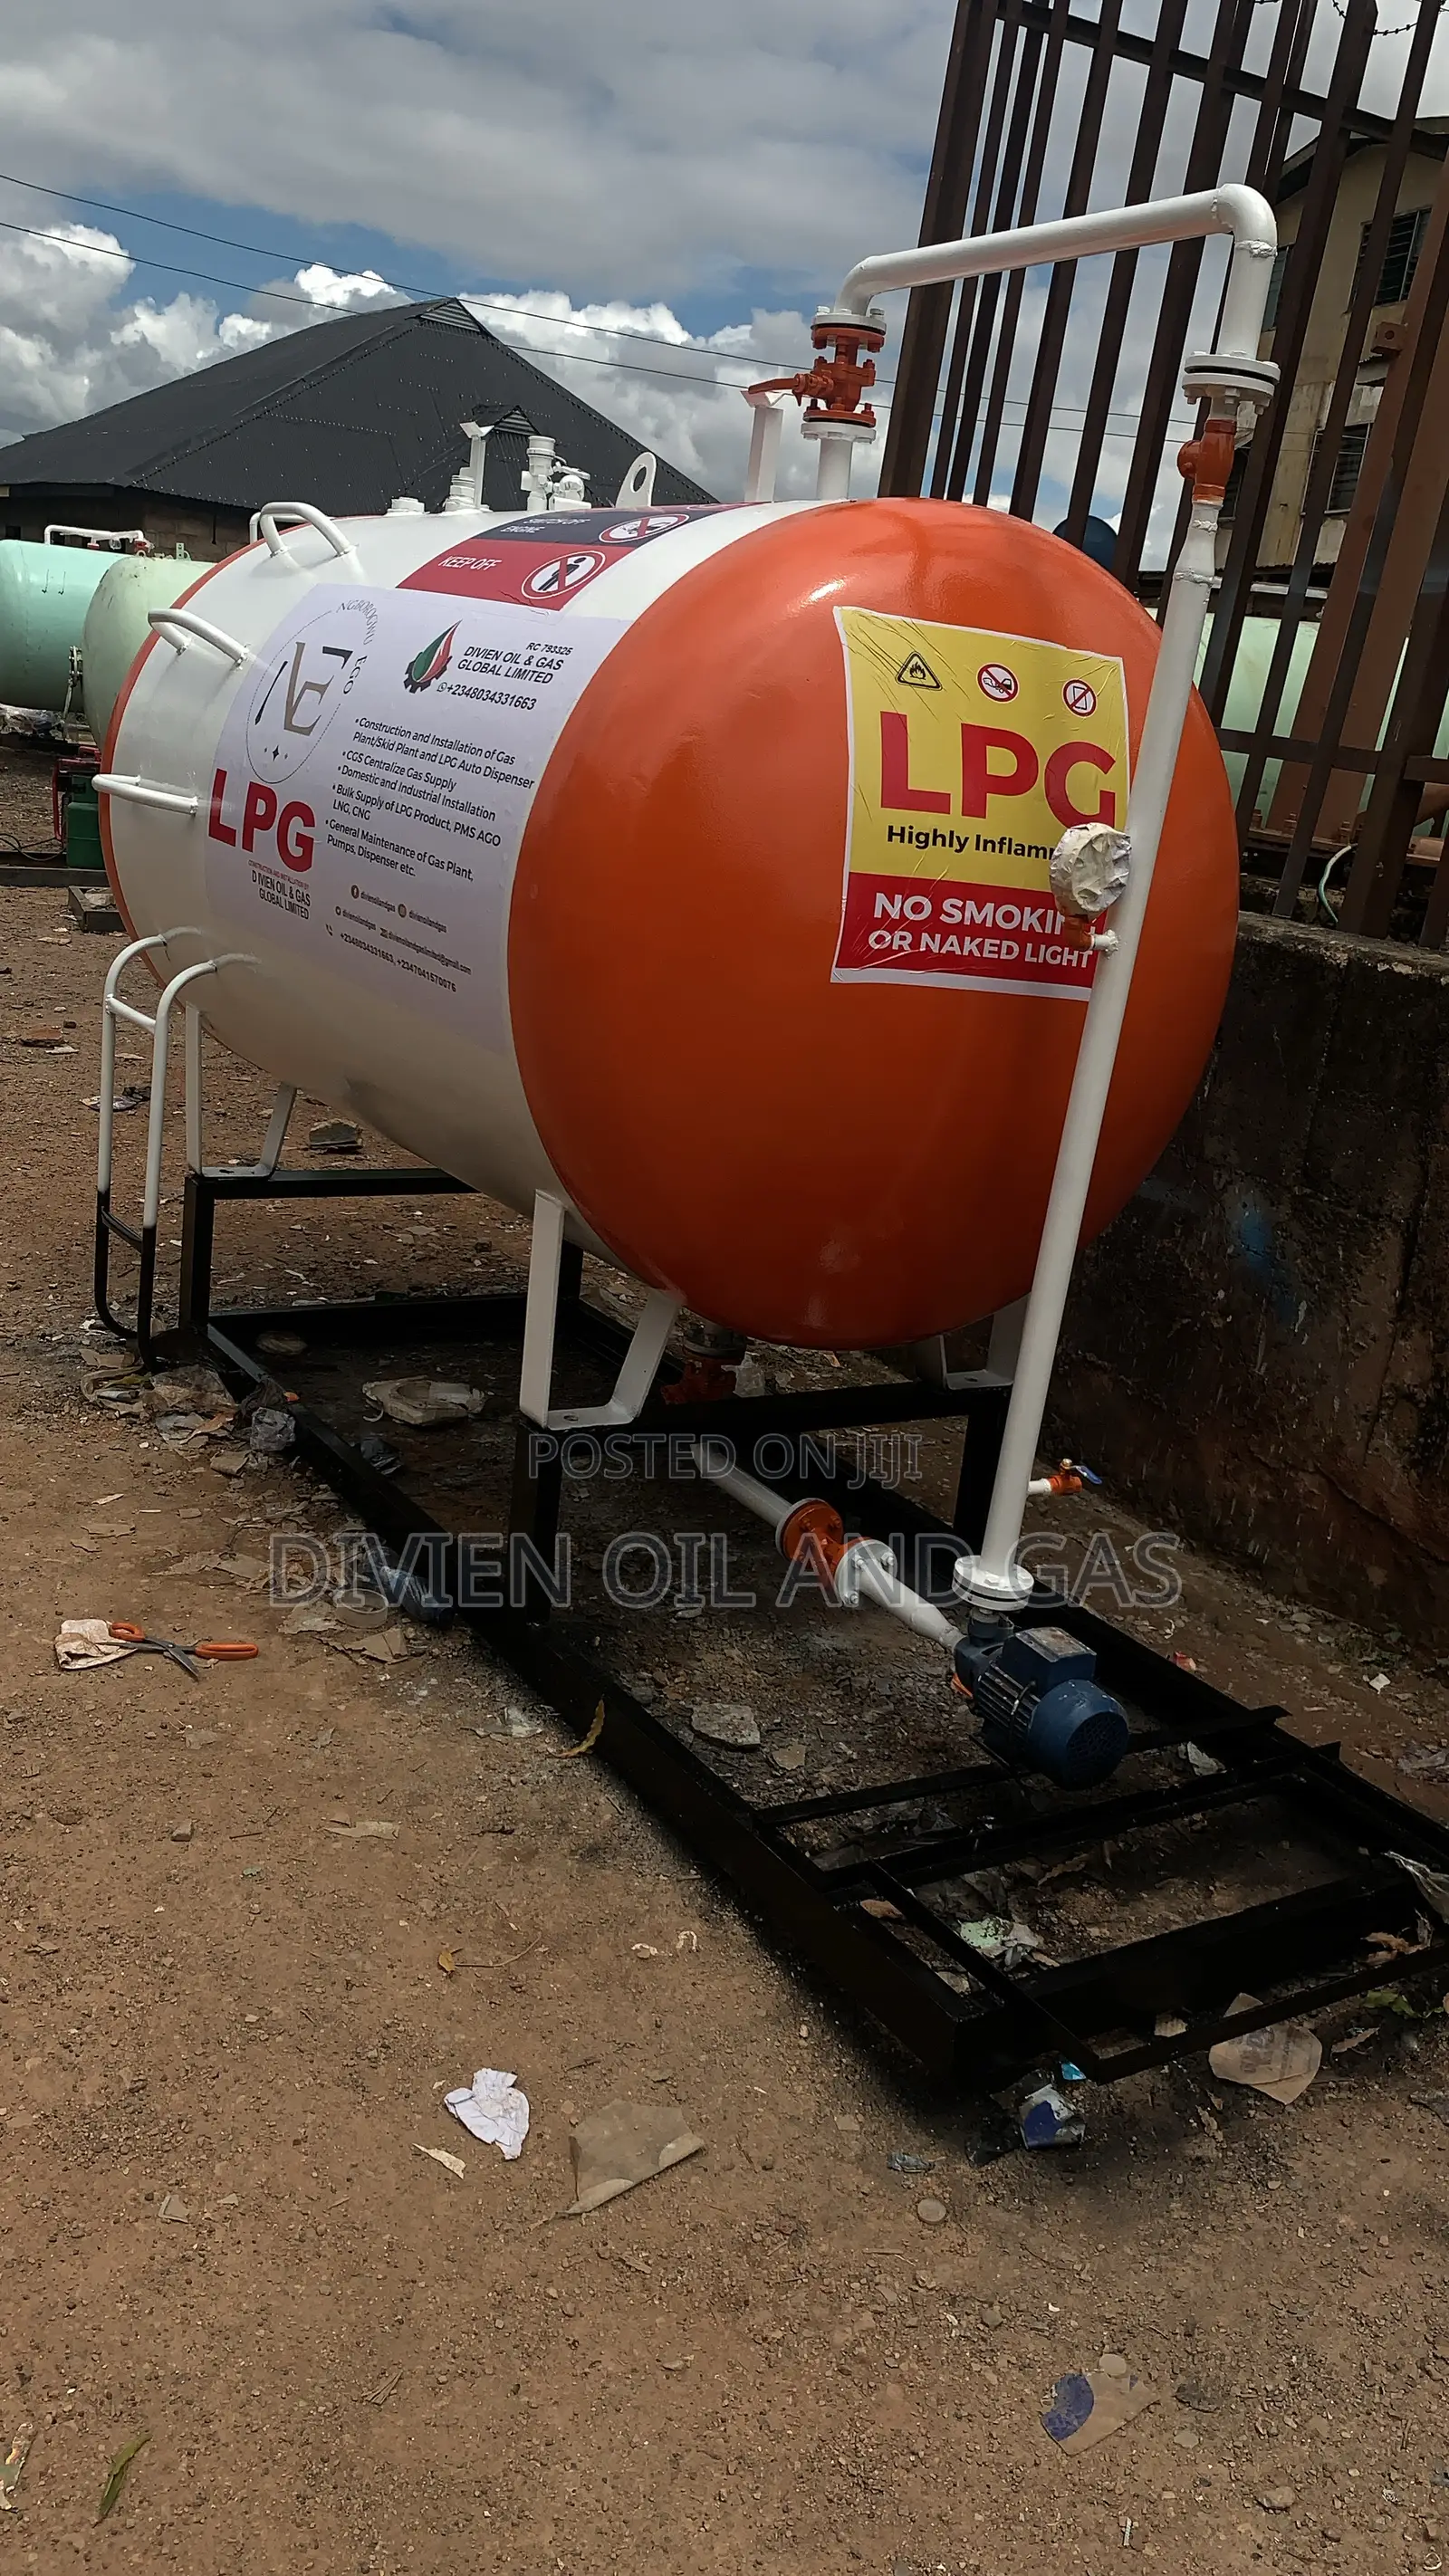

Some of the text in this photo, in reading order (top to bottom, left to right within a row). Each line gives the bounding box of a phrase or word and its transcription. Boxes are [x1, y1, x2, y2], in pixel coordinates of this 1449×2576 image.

[438, 556, 503, 570] KEEP OFF
[464, 646, 564, 671] DIVIEN OIL & GAS
[526, 642, 541, 652] RC
[457, 659, 553, 685] GLOBAL LIMITED
[447, 684, 537, 711] +2348034331663
[359, 717, 516, 766] Construction and Installation of Gas
[346, 750, 457, 792] CGS Centralize Gas Supply
[352, 731, 535, 790] Plant/Skid Plant and LPG Auto Dispenser
[879, 710, 1116, 828] LPG
[333, 799, 371, 821] LNG, CNG
[341, 764, 496, 821] Domestic and Industrial Installation
[208, 768, 315, 873] LPG
[337, 784, 502, 847] Bulk Supply of LPG Product, PMS AGO
[327, 834, 417, 877] Pumps, Dispenser etc.
[329, 819, 474, 882] General Maintenance of Gas Plant,
[888, 825, 970, 854] Highly
[259, 887, 309, 920] GLOBAL LIMITED
[275, 881, 288, 897] OIL
[289, 886, 294, 901] &
[295, 889, 311, 907] GAS
[874, 892, 932, 921] NO
[868, 930, 1093, 968] OR NAKED LIGHT
